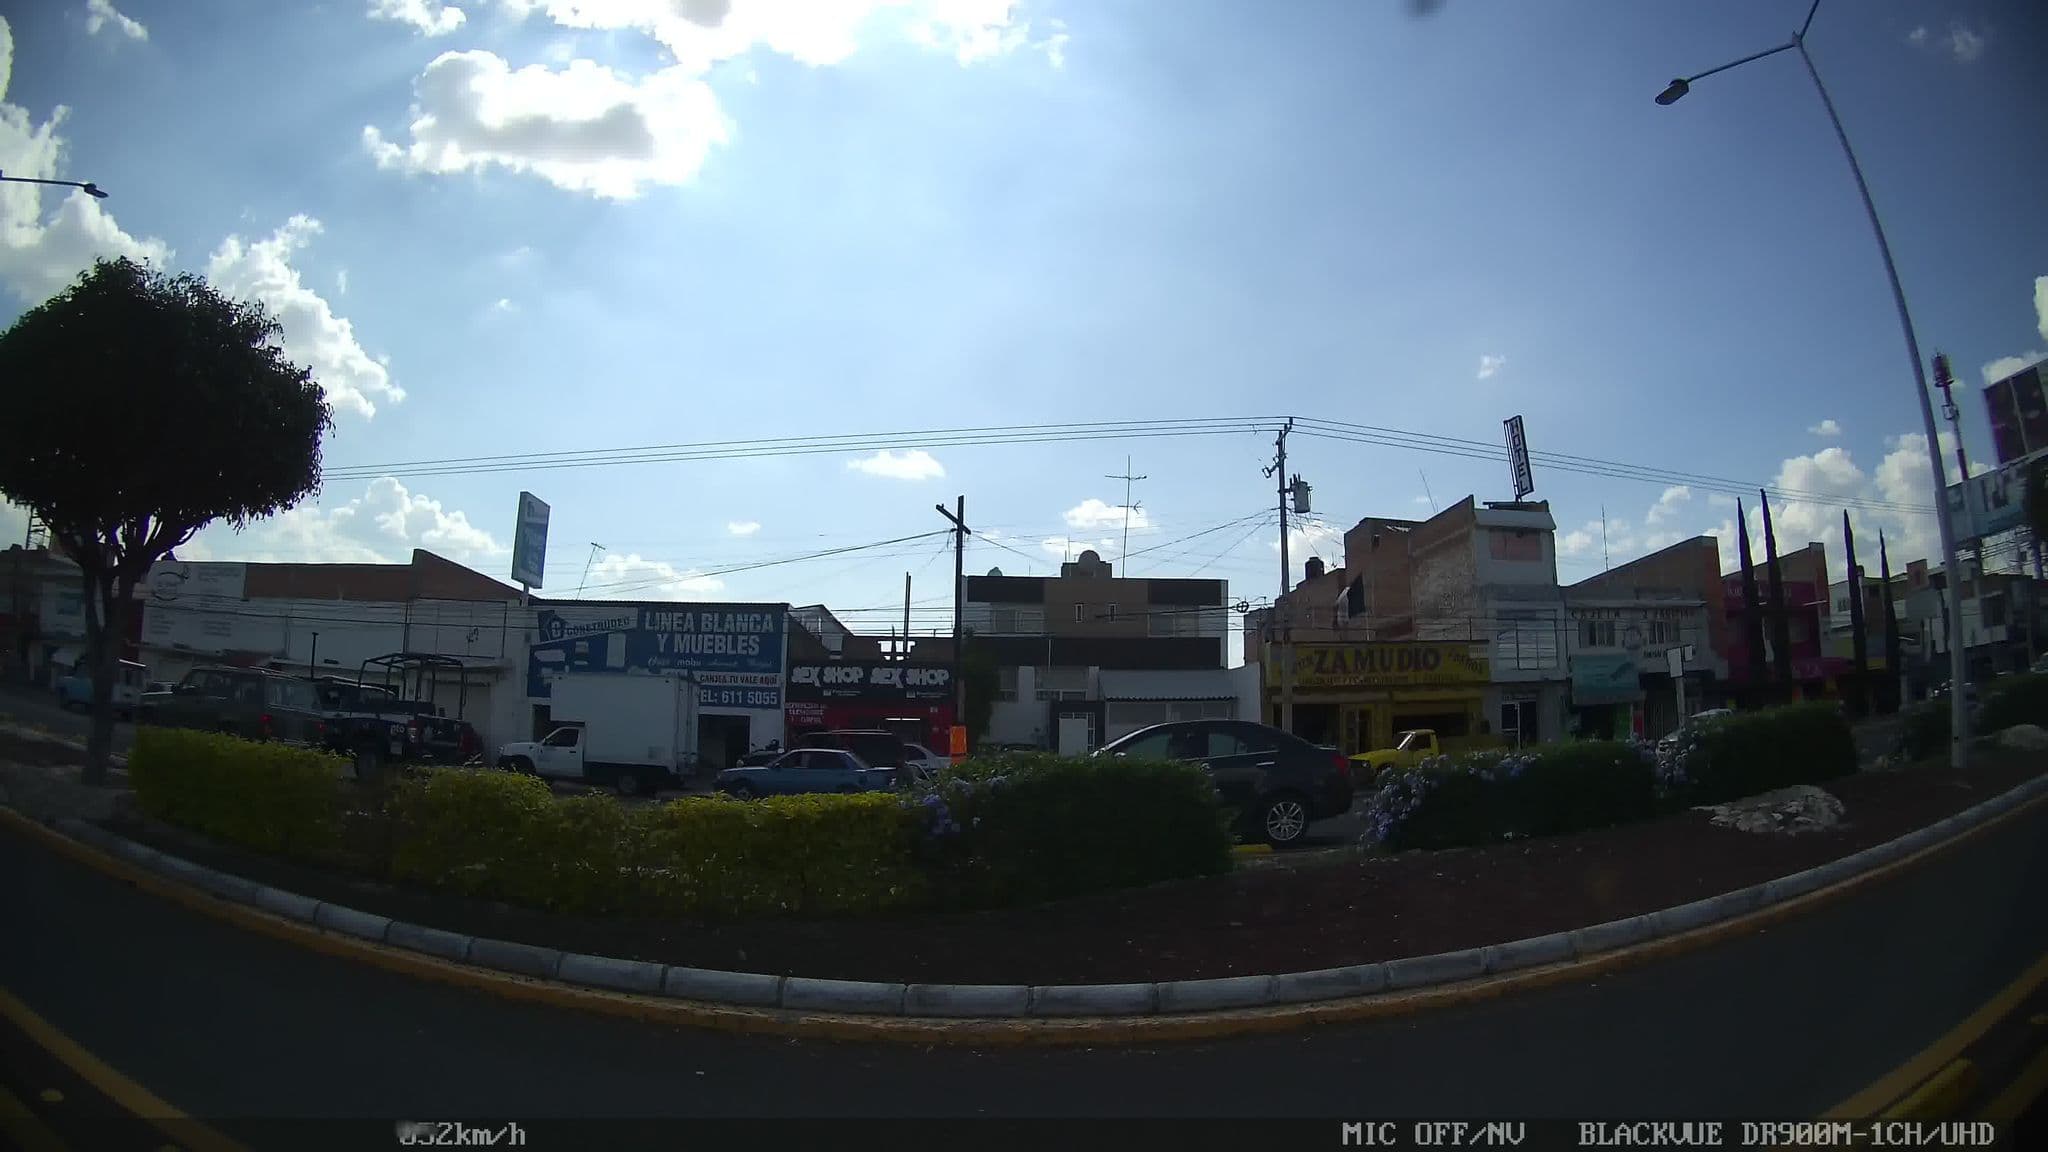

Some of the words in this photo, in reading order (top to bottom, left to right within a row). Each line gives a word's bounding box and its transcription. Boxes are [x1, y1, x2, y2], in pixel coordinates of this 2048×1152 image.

[1509, 420, 1529, 493] HOTEL
[644, 611, 696, 633] LINEA
[701, 612, 774, 634] BLANCA
[656, 634, 669, 653] Y
[674, 634, 760, 655] MUEBLES
[1313, 647, 1442, 674] ZAMUDIO
[729, 675, 738, 684] TU
[740, 675, 758, 684] VALE
[791, 666, 822, 687] SEX
[823, 666, 864, 684] SHOP
[870, 667, 904, 688] SEX
[906, 668, 950, 686] SHOP
[722, 690, 742, 704] 611
[747, 691, 778, 705] 5055
